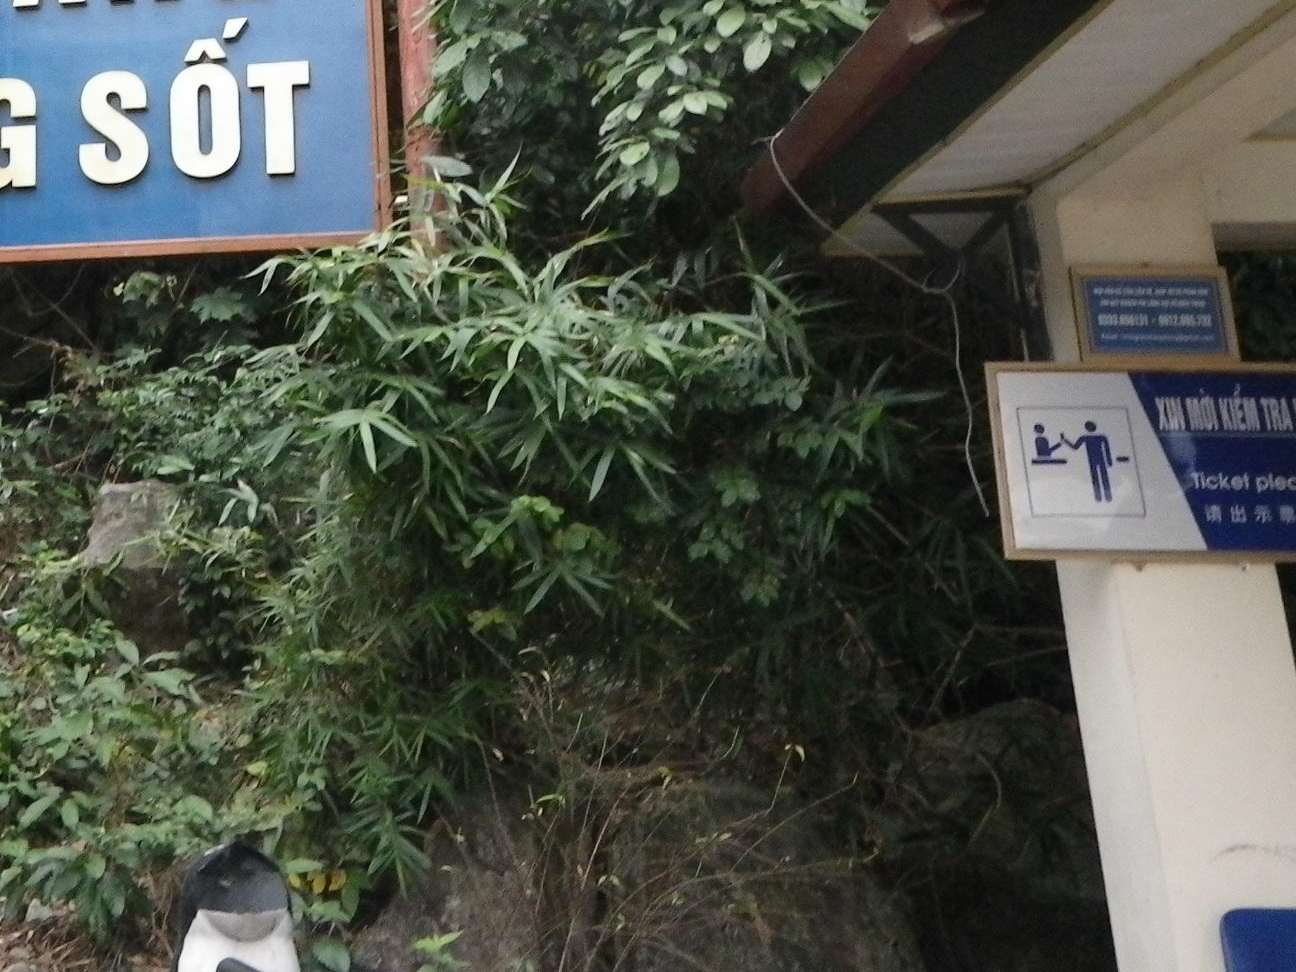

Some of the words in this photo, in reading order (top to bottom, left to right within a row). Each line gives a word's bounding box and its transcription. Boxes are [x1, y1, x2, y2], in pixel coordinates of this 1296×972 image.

[77, 16, 311, 186] SỐT
[1260, 396, 1294, 431] TRA
[1191, 471, 1250, 490] Ticket
